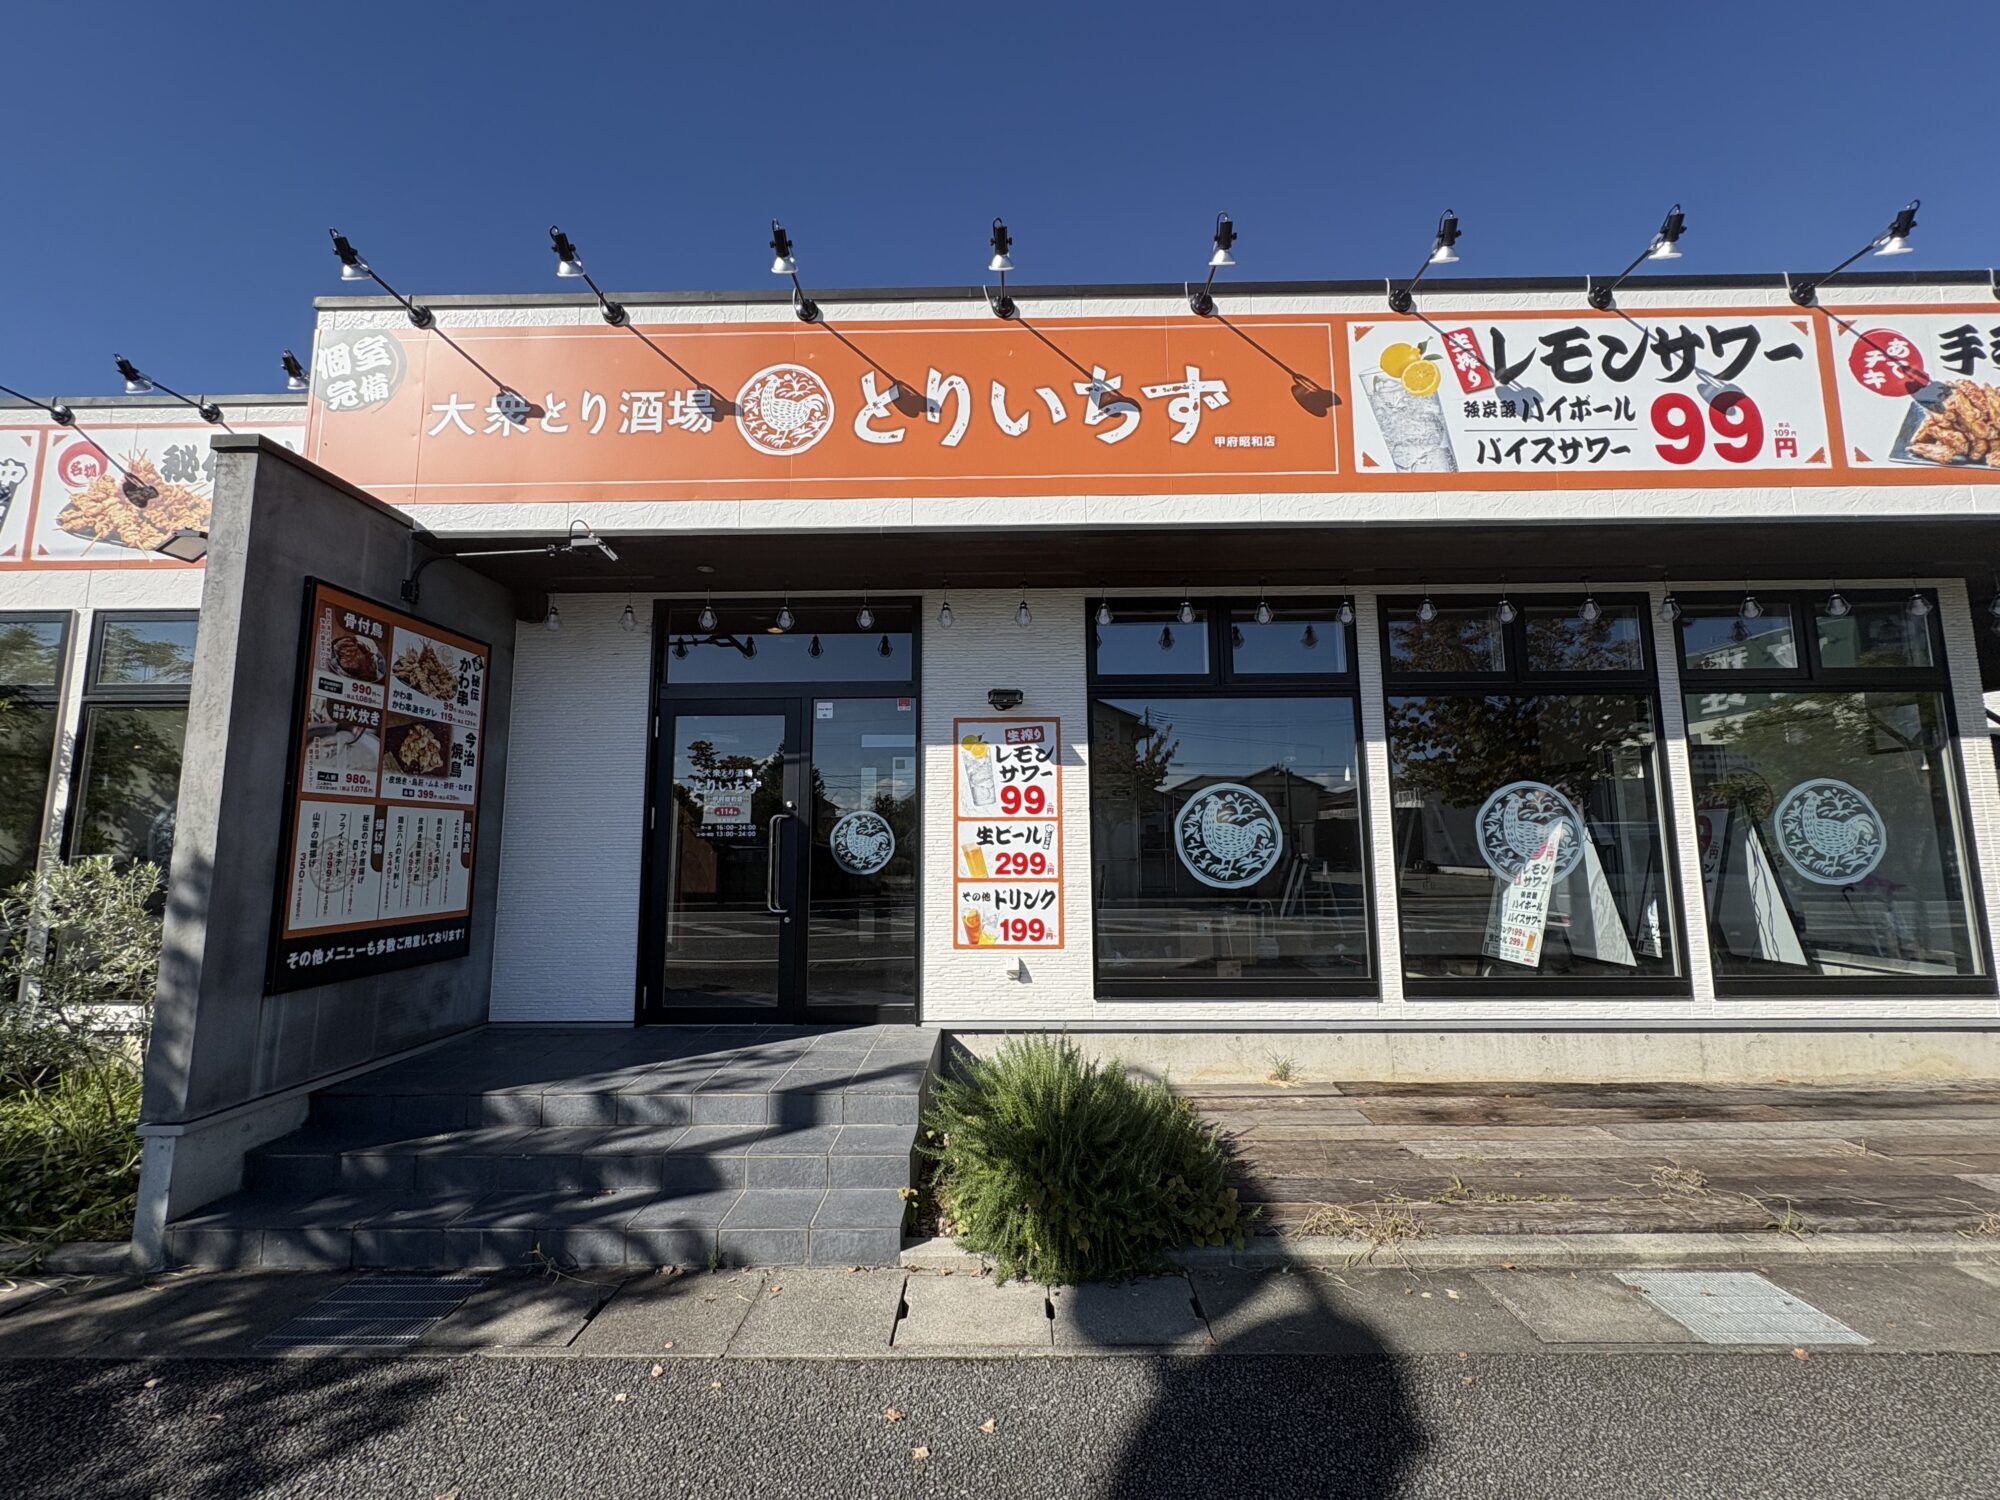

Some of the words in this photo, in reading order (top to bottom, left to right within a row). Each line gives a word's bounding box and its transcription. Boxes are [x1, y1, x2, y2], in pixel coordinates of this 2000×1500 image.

[317, 335, 392, 380] 個室
[1448, 332, 1482, 389] 生搾り
[1489, 325, 1804, 385] レモンサワー
[326, 372, 389, 410] 完備
[427, 389, 716, 437] 大衆とり酒場
[853, 364, 1231, 448] とりいちず
[1464, 400, 1516, 418] 強炭酸
[1522, 395, 1636, 422] ハイボール
[1213, 435, 1276, 449] 甲府昭和店
[1476, 435, 1631, 465] バイスサワー
[393, 690, 413, 701] かわ串
[457, 657, 471, 706] かわ串
[346, 706, 381, 726] 水炊き
[449, 743, 463, 778] 焼鳥
[464, 732, 476, 767] 今治
[995, 745, 1054, 763] レモン
[694, 778, 762, 794] とりいちず
[999, 765, 1053, 783] サワー
[335, 813, 347, 876] フライドポテト
[373, 818, 385, 854] 揚げ物
[976, 826, 1042, 845] 生ビール
[962, 892, 991, 902] その他
[994, 889, 1056, 910] ドリンク
